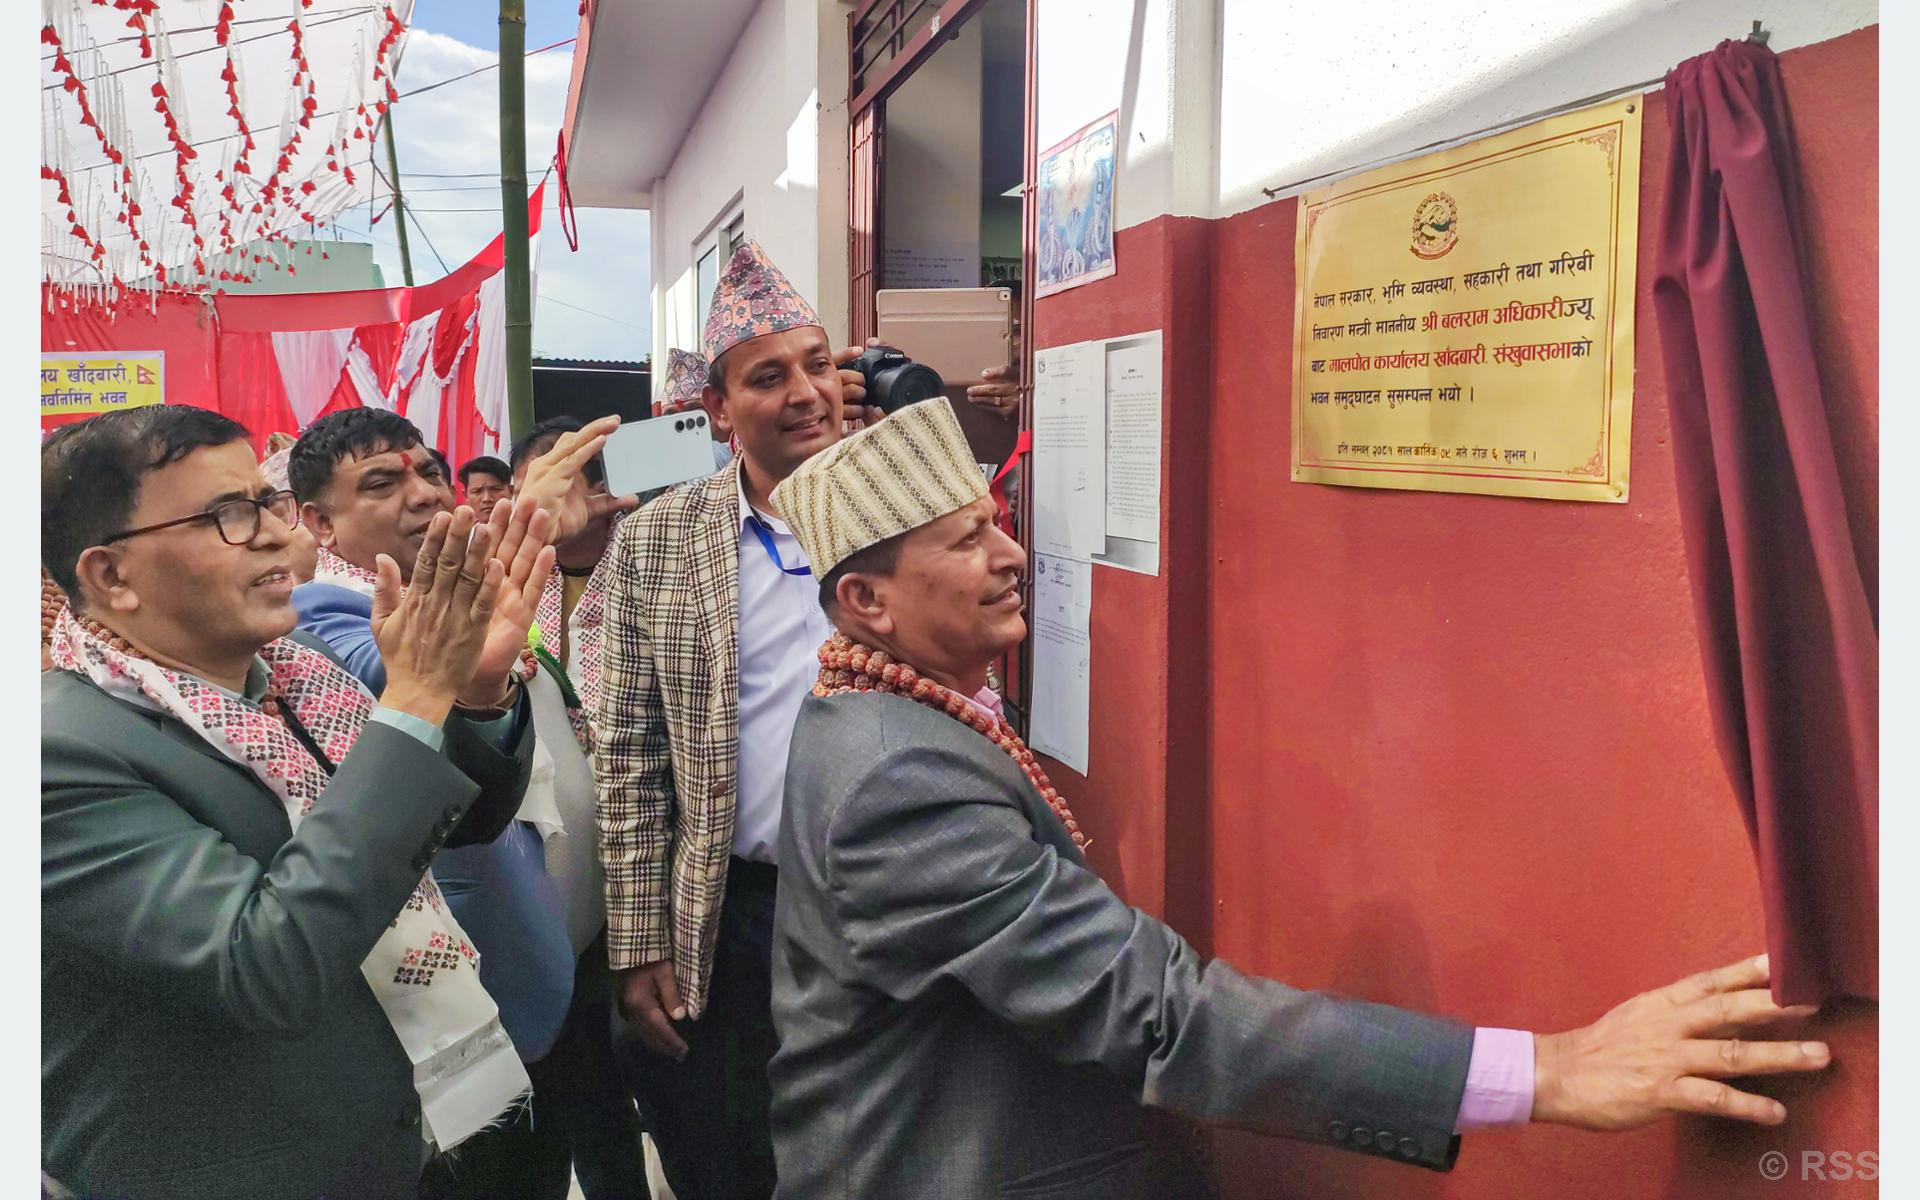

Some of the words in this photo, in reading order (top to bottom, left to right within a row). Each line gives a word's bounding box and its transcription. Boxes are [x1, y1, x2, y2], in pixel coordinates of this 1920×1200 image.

[1314, 293, 1336, 308] नेपाल
[1339, 287, 1376, 306] सरकार,
[1382, 279, 1406, 304] भूमि
[1411, 276, 1456, 295] व्यवस्था,
[1463, 262, 1510, 291] सहकारी
[1516, 262, 1543, 281] तथा
[1549, 248, 1595, 277] गरिबी
[1312, 323, 1344, 342] निवारण
[1348, 318, 1371, 337] मन्त्री
[1376, 314, 1416, 335] माननीय
[1421, 310, 1438, 333] श्री
[1441, 309, 1490, 329] बलराम
[1311, 360, 1326, 373] बाट
[1328, 352, 1371, 373] मालपोत
[1374, 350, 1430, 370] कार्यालय
[100, 391, 127, 404] भवन
[1311, 392, 1329, 404] भवन
[1387, 388, 1432, 409] सुसम्पन्न
[1438, 383, 1462, 402] भयो
[1456, 446, 1468, 458] गते
[1472, 446, 1488, 460] रोज
